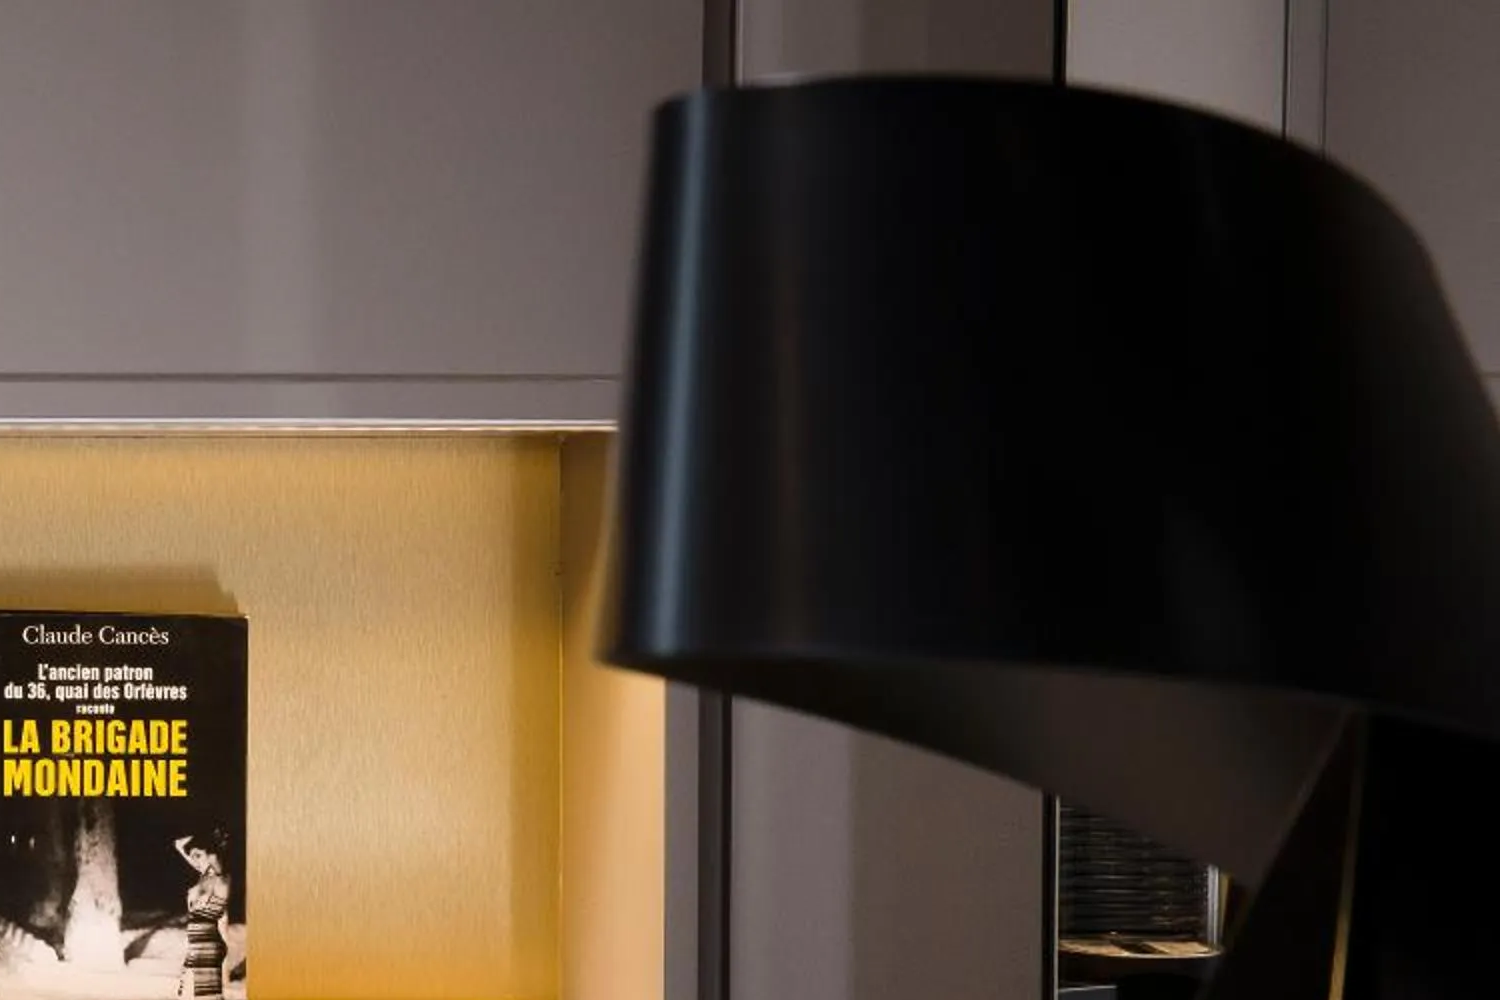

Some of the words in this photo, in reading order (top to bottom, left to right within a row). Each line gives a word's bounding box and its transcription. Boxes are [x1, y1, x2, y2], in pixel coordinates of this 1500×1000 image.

[22, 624, 92, 645] Claude
[98, 625, 169, 645] Cancès
[38, 663, 100, 681] L'ancien
[104, 665, 153, 682] patron
[4, 682, 23, 699] du
[28, 682, 50, 700] 36,
[55, 683, 89, 702] quai
[93, 683, 120, 699] des
[124, 682, 187, 699] Orfèvres
[3, 719, 40, 754] LA
[52, 719, 188, 754] BRIGADE
[3, 759, 188, 797] MONDAINE
